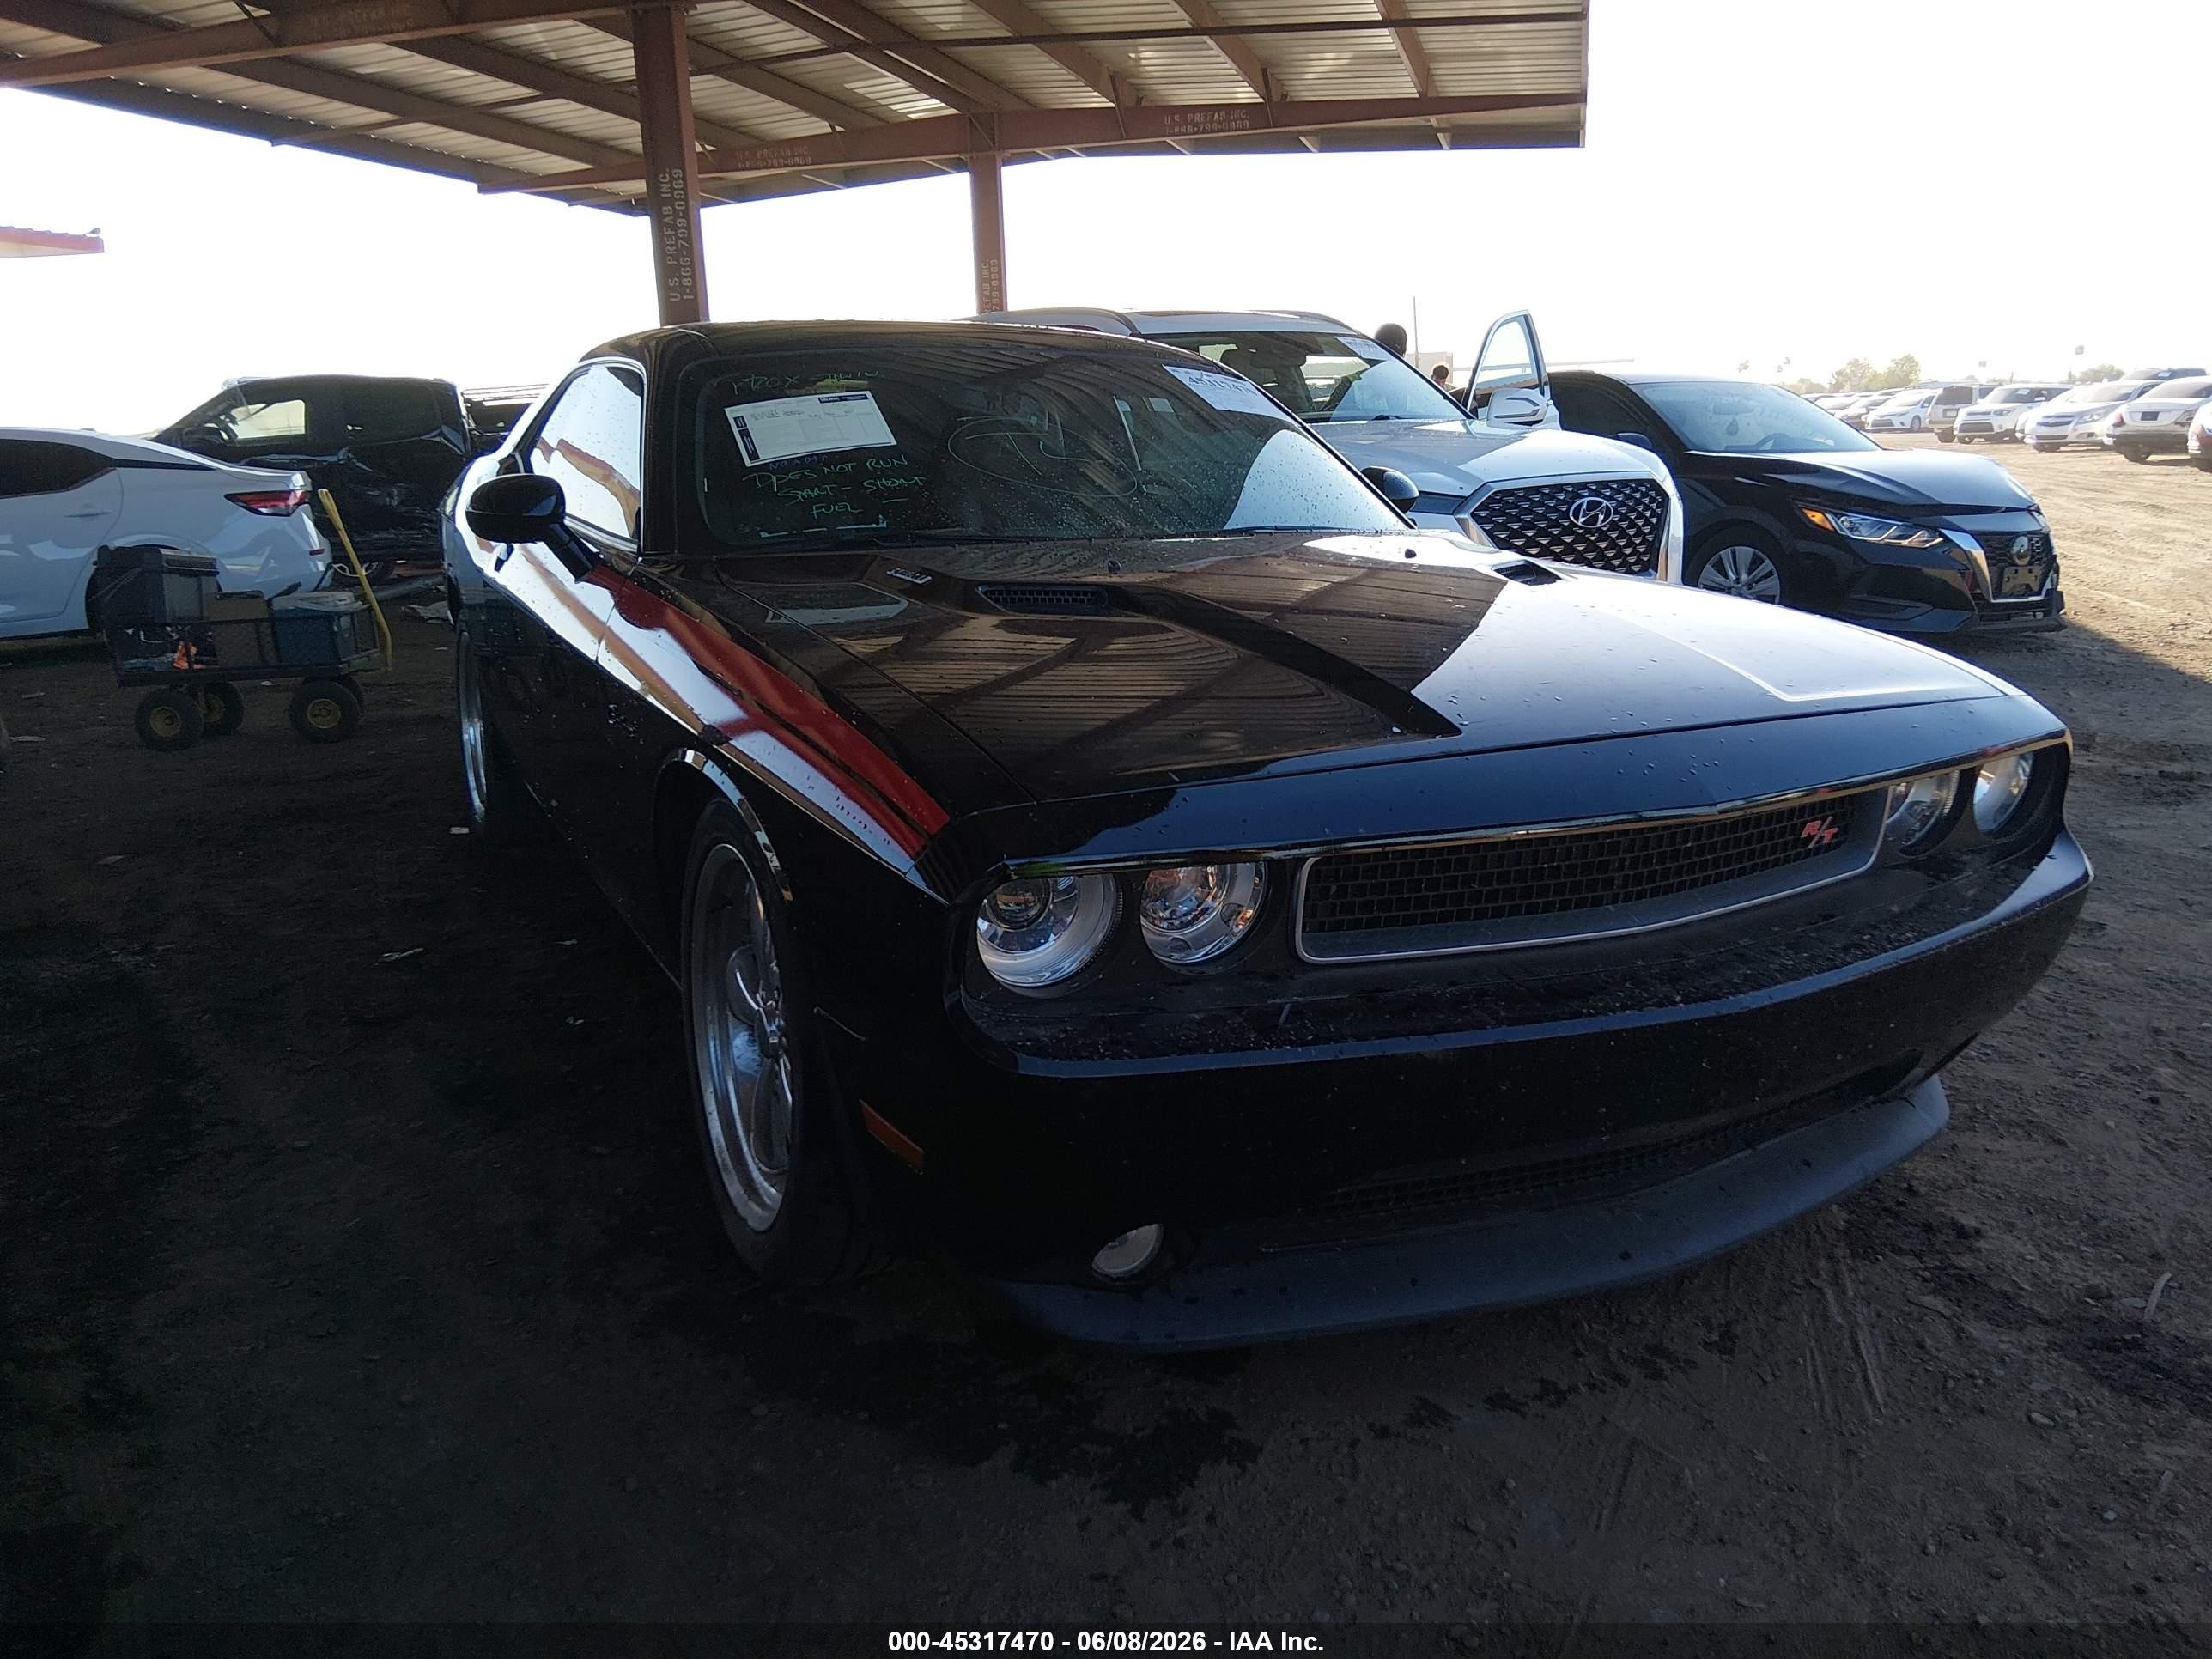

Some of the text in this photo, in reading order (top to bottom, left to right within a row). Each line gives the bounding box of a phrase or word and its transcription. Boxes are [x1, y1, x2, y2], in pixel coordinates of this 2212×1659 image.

[659, 167, 681, 302] U.S. PREFAB INC.
[823, 463, 857, 474] NOT
[866, 454, 908, 470] RUN
[810, 501, 864, 520] FUEL
